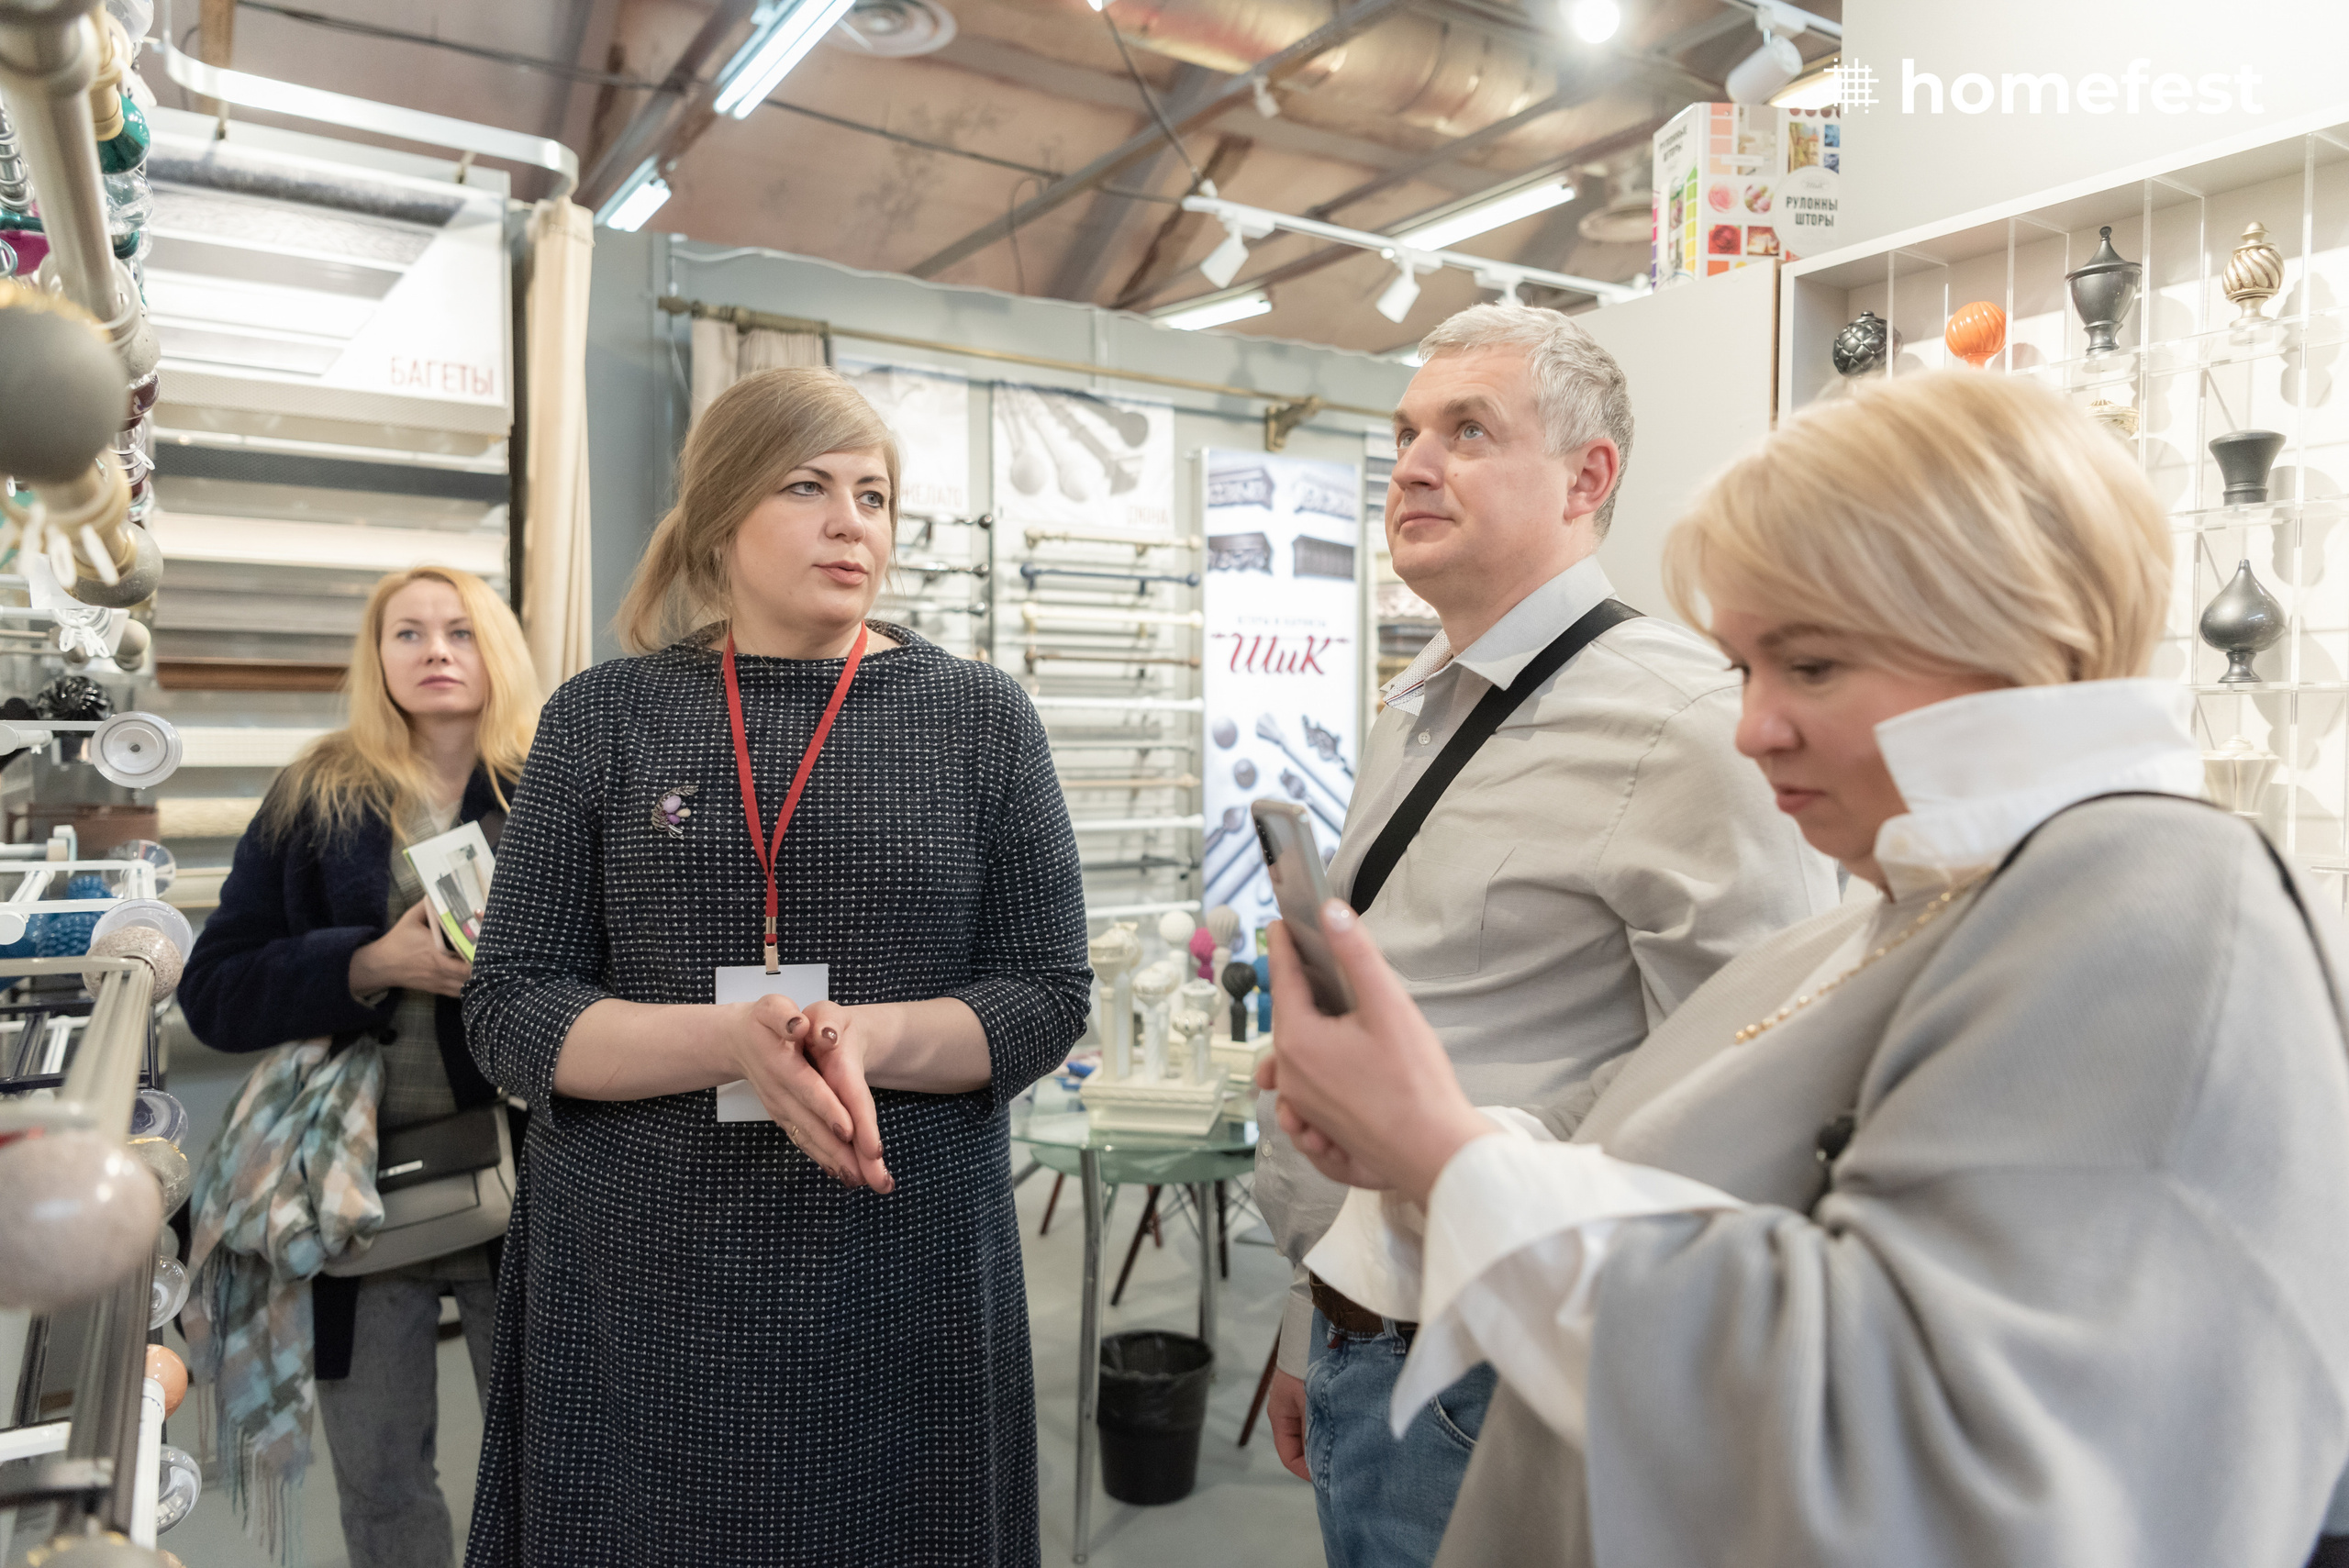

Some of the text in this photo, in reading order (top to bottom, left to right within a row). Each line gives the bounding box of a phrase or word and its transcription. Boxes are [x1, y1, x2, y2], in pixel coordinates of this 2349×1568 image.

[1786, 195, 1839, 212] РУЛОННЫ
[1795, 213, 1834, 228] ШТОРЫ
[390, 356, 494, 395] БАГЕТЫ
